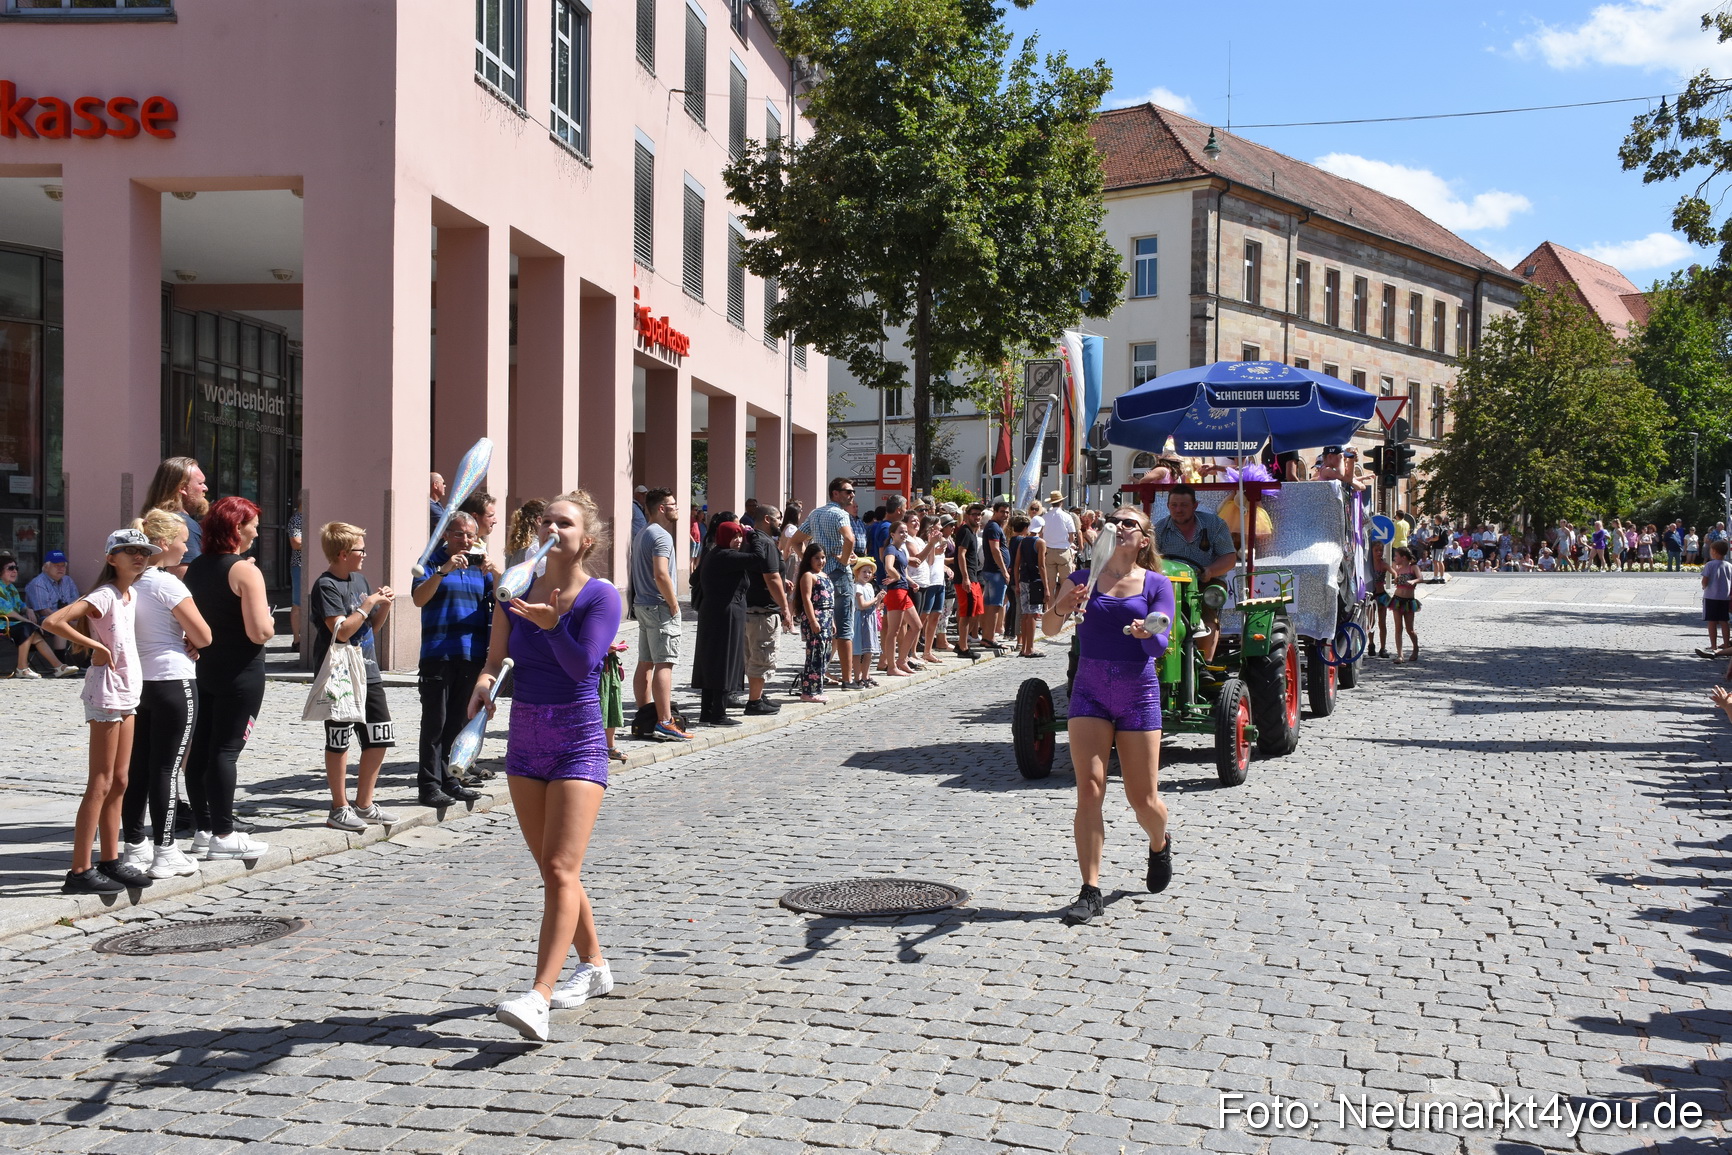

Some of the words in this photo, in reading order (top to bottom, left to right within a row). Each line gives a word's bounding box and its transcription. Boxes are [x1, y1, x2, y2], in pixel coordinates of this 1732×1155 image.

[640, 306, 690, 357] Sparkasse
[1038, 371, 1050, 380] 30
[204, 383, 285, 417] wochenblatt
[1215, 390, 1264, 400] SCHNEIDER
[1266, 390, 1300, 400] WEISSE
[203, 411, 237, 429] Ticketshop
[245, 420, 255, 431] der
[256, 421, 284, 436] Sparkasse
[860, 465, 875, 473] AOK
[184, 688, 193, 698] NO
[180, 724, 192, 746] WORDS
[178, 746, 186, 755] NO
[168, 799, 176, 808] NO
